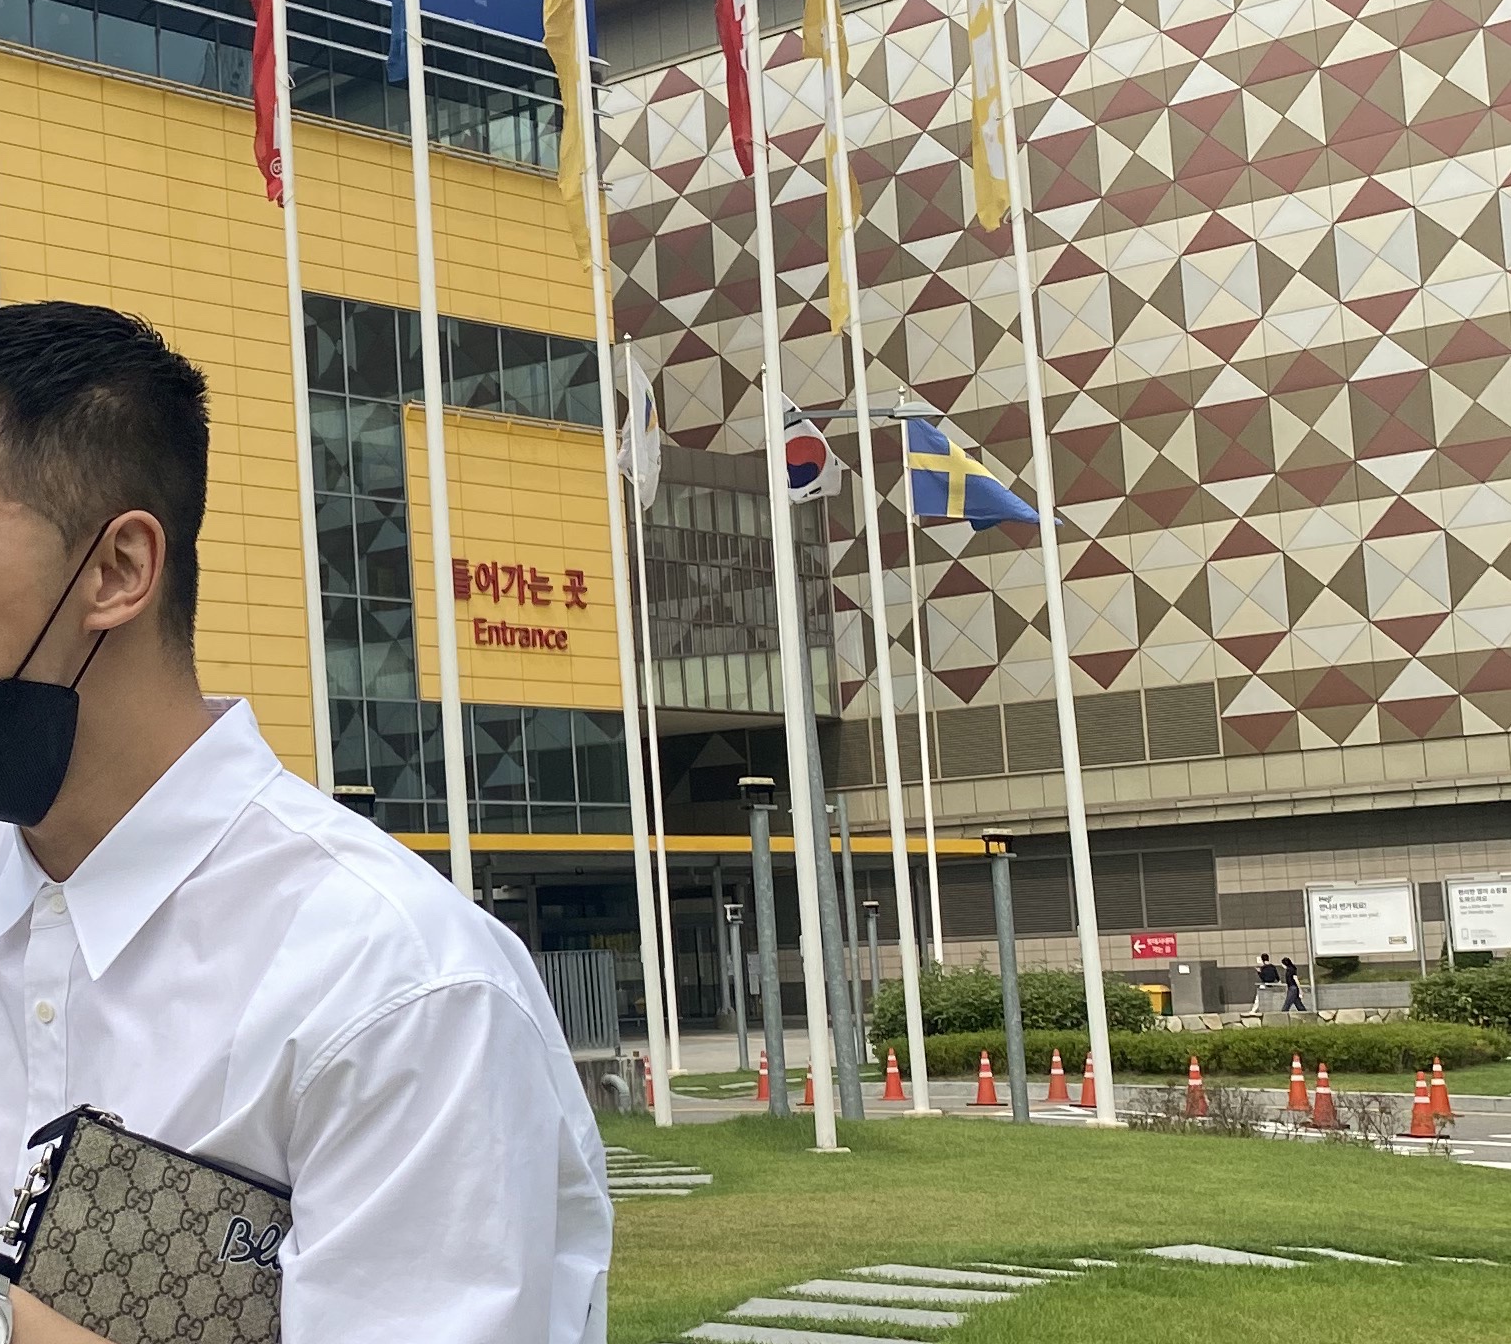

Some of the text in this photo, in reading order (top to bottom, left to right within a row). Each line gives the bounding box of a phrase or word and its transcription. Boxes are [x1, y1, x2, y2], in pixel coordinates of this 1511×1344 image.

[451, 558, 588, 610] 들어가는 곳
[473, 617, 569, 651] Entrance
